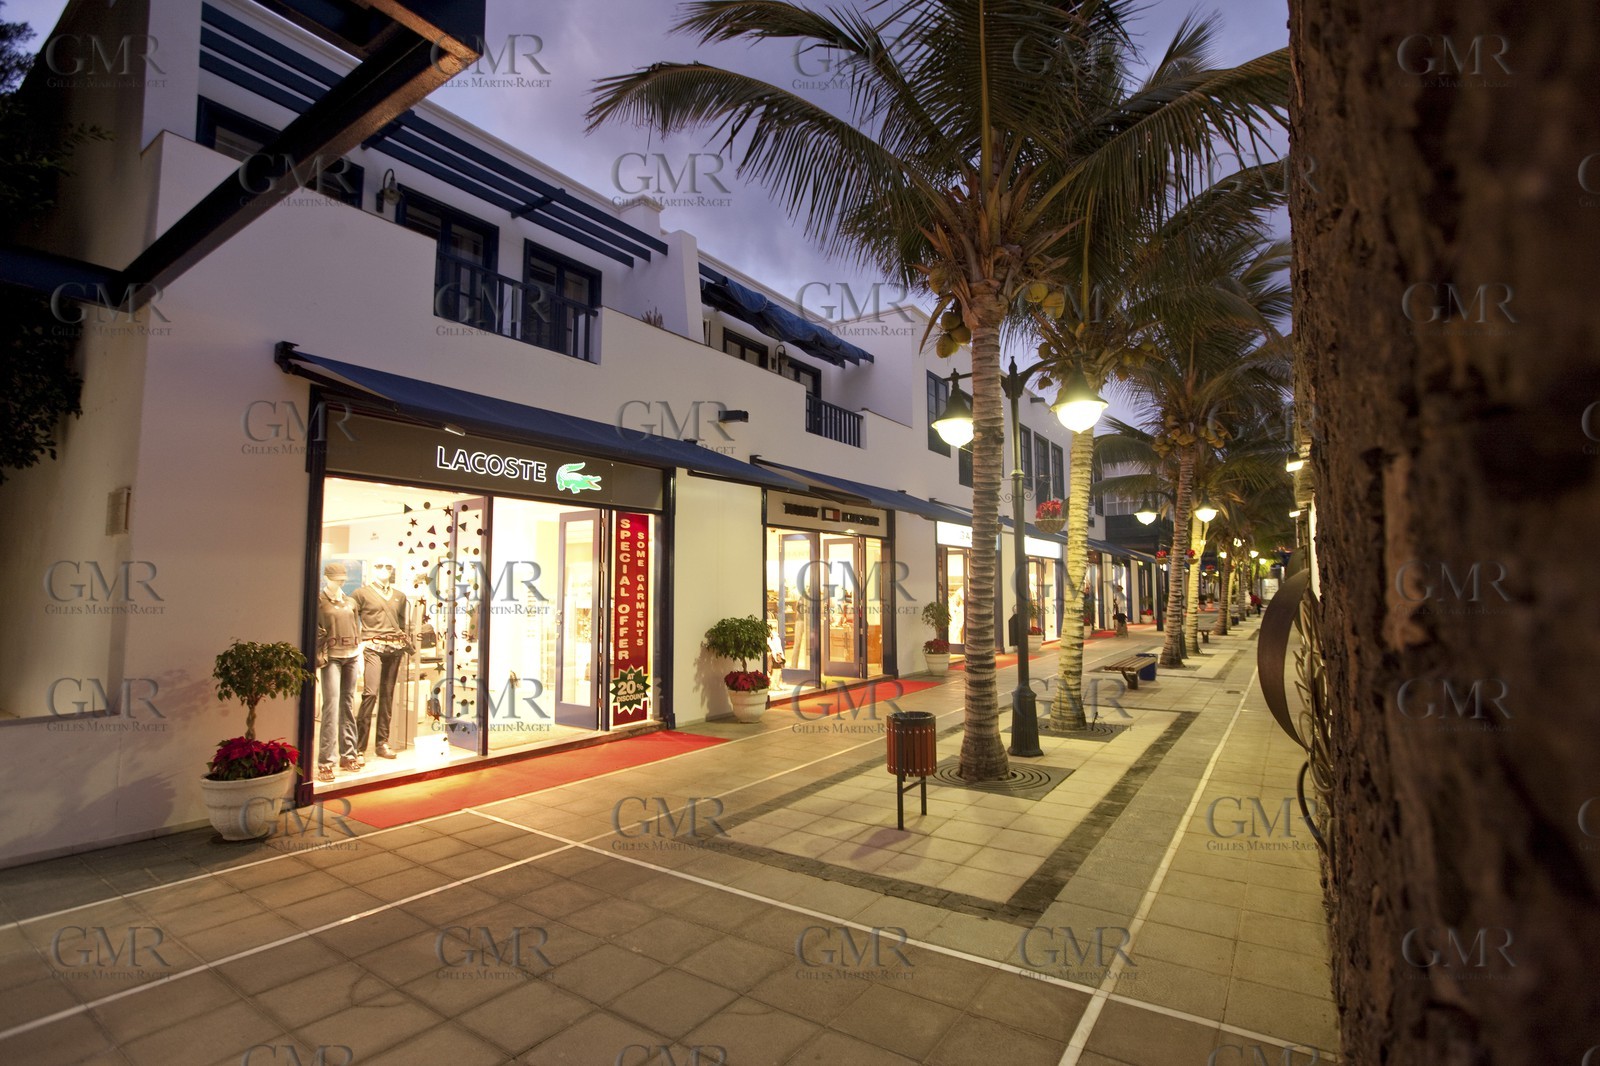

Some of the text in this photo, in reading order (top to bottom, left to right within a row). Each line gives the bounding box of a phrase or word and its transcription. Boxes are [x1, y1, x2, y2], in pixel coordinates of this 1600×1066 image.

[436, 445, 547, 483] LACOSTE
[617, 518, 631, 660] SPECIAL OFFER
[635, 532, 646, 646] SOME GARMENTS
[616, 691, 645, 703] DISCOUNT
[617, 680, 644, 696] 20%
